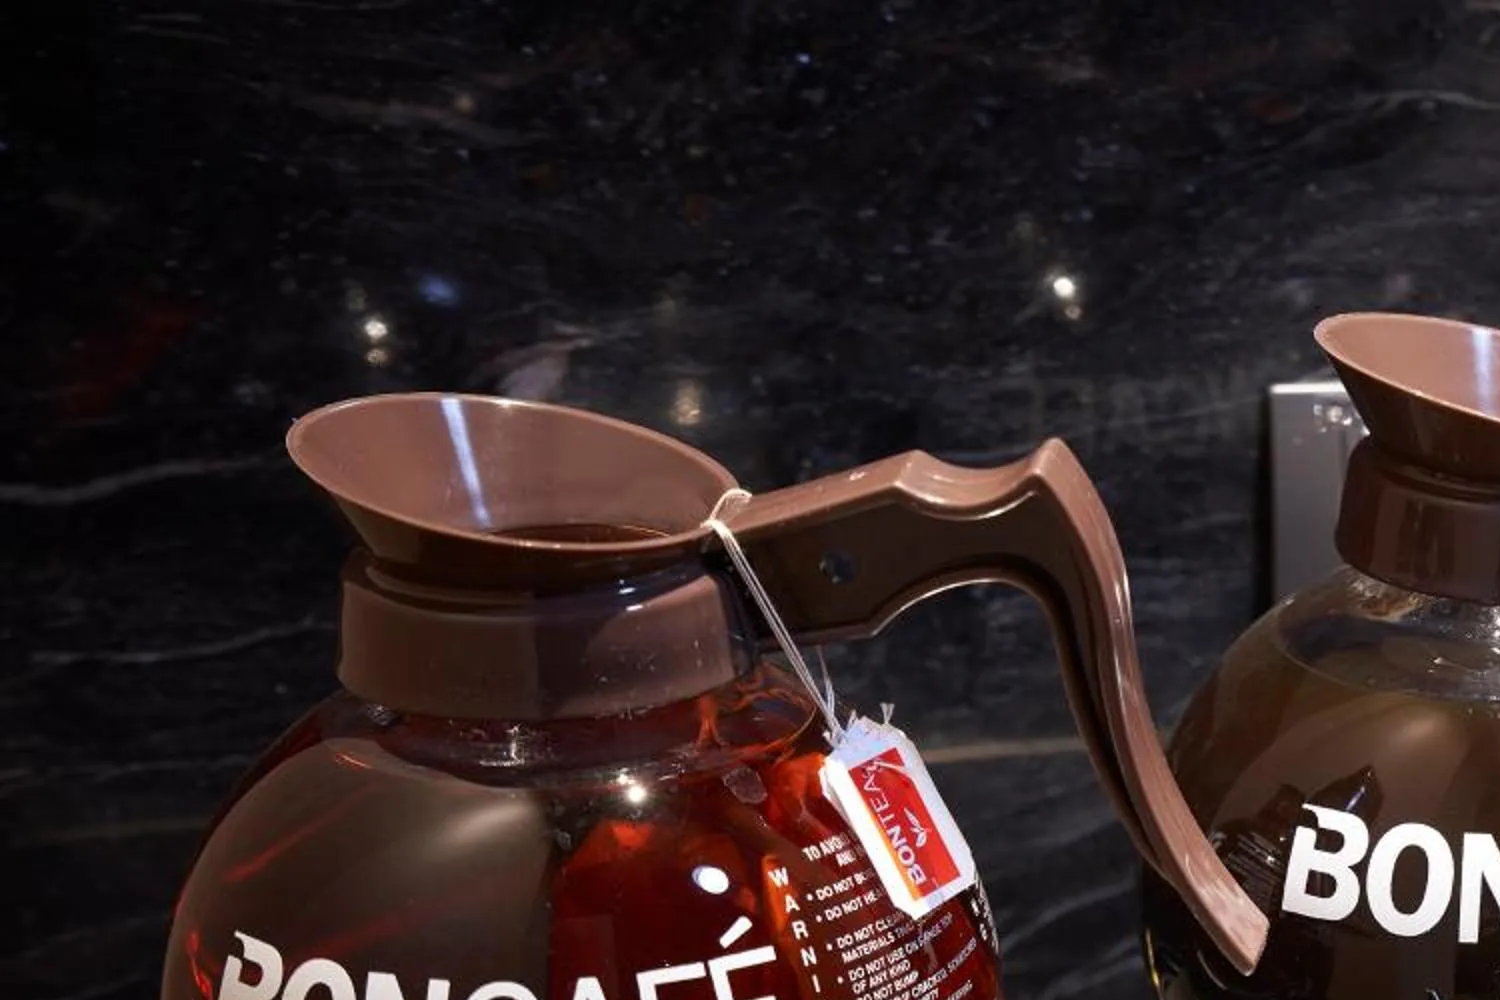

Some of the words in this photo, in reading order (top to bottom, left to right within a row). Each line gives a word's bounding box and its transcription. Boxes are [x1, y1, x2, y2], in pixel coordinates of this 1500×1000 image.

[863, 771, 928, 886] BONTEA
[802, 845, 821, 861] TO
[816, 885, 833, 900] DO
[833, 876, 854, 894] NOT
[825, 905, 842, 921] DO
[842, 896, 863, 914] NOT
[836, 934, 853, 949] DO
[853, 924, 875, 942] NOT
[848, 967, 865, 981] DO
[865, 956, 886, 974] NOT
[886, 947, 906, 964] USE
[852, 979, 867, 994] OF
[869, 971, 888, 988] ANY
[873, 984, 893, 1000] NOT
